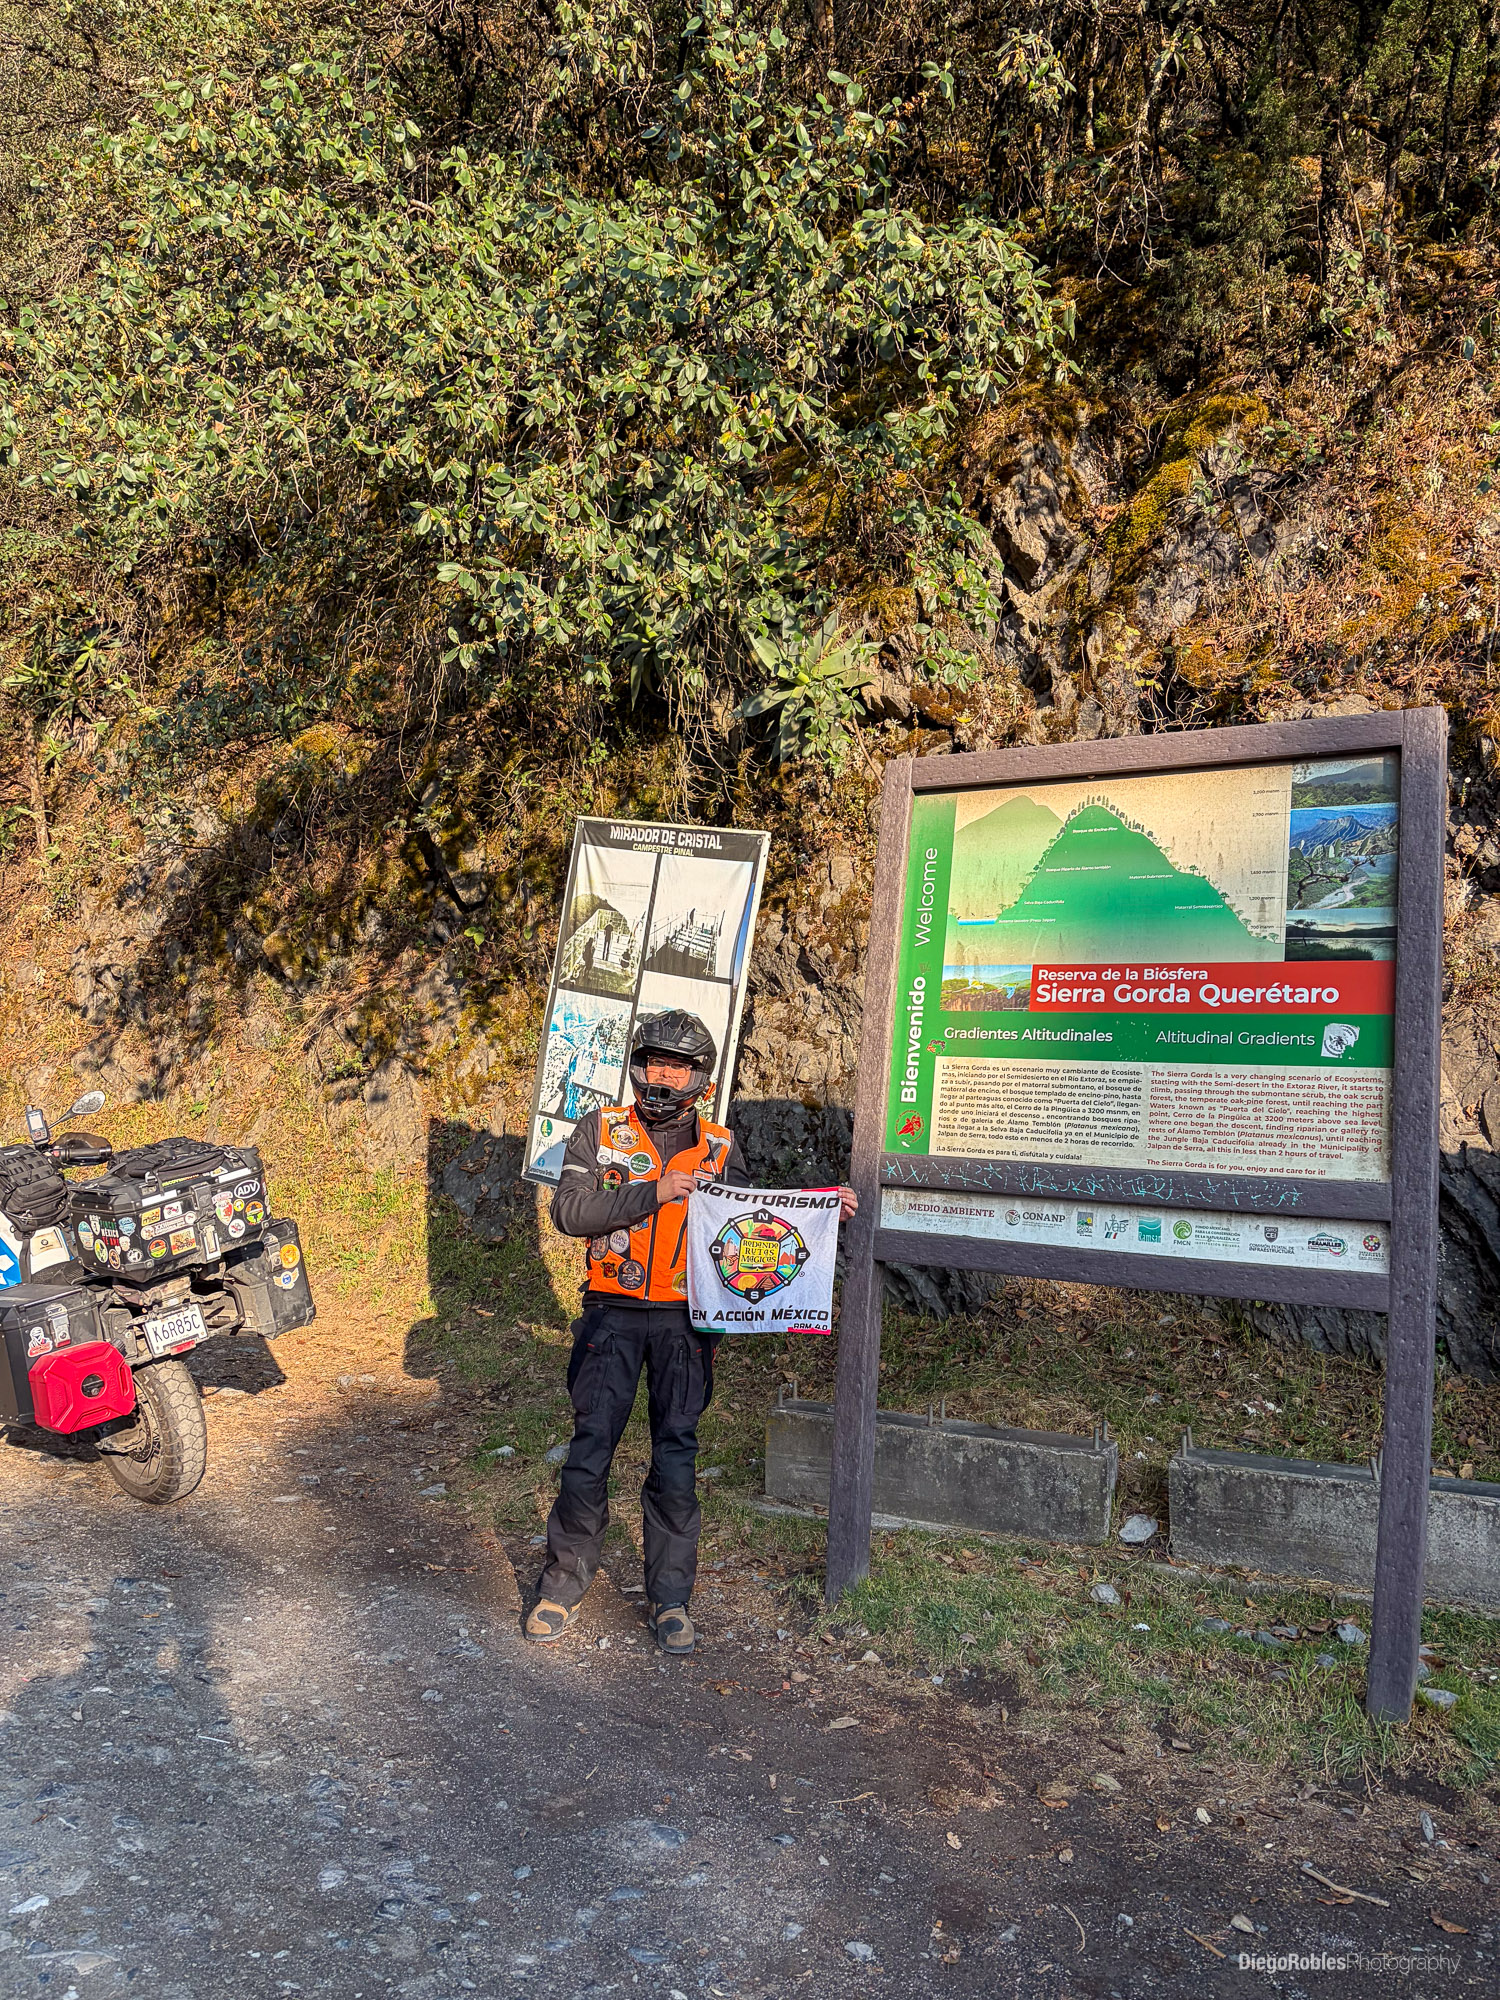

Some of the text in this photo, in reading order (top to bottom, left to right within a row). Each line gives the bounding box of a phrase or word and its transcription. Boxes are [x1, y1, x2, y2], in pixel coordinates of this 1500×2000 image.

[610, 826, 722, 850] MIRADOR DE CRISTAL
[633, 843, 694, 856] CAMPESTRE PINAL
[914, 848, 938, 948] Welcome
[1038, 967, 1208, 980] Reserva de la Biósfera
[1036, 982, 1339, 1007] Sierra Gorda Querétaro
[900, 977, 926, 1103] Bienvenido
[944, 1027, 1113, 1042] Gradientes Altitudinales
[1156, 1030, 1316, 1046] Altitudinal Gradients
[1118, 1076, 1142, 1085] empie-
[1151, 1078, 1179, 1087] starting
[1318, 1083, 1339, 1091] River,
[1250, 1073, 1286, 1081] changing
[1335, 1075, 1385, 1084] Ecosystems,
[947, 1145, 965, 1153] Sierra
[967, 1146, 986, 1154] Gorda
[1185, 1160, 1206, 1168] Gorda
[1229, 1164, 1244, 1172] you,
[1247, 1165, 1267, 1173] enjoy
[237, 1182, 256, 1195] ADV
[697, 1181, 840, 1209] MOTOTURISMO
[908, 1203, 940, 1212] MEDIO
[942, 1206, 995, 1218] AMBIENTE
[1022, 1212, 1065, 1222] CONANP
[1139, 1232, 1161, 1243] Ramsar
[750, 1291, 760, 1299] S
[692, 1305, 829, 1322] EN ACCIÓN MÉXICO
[152, 1314, 200, 1342] K6R85C
